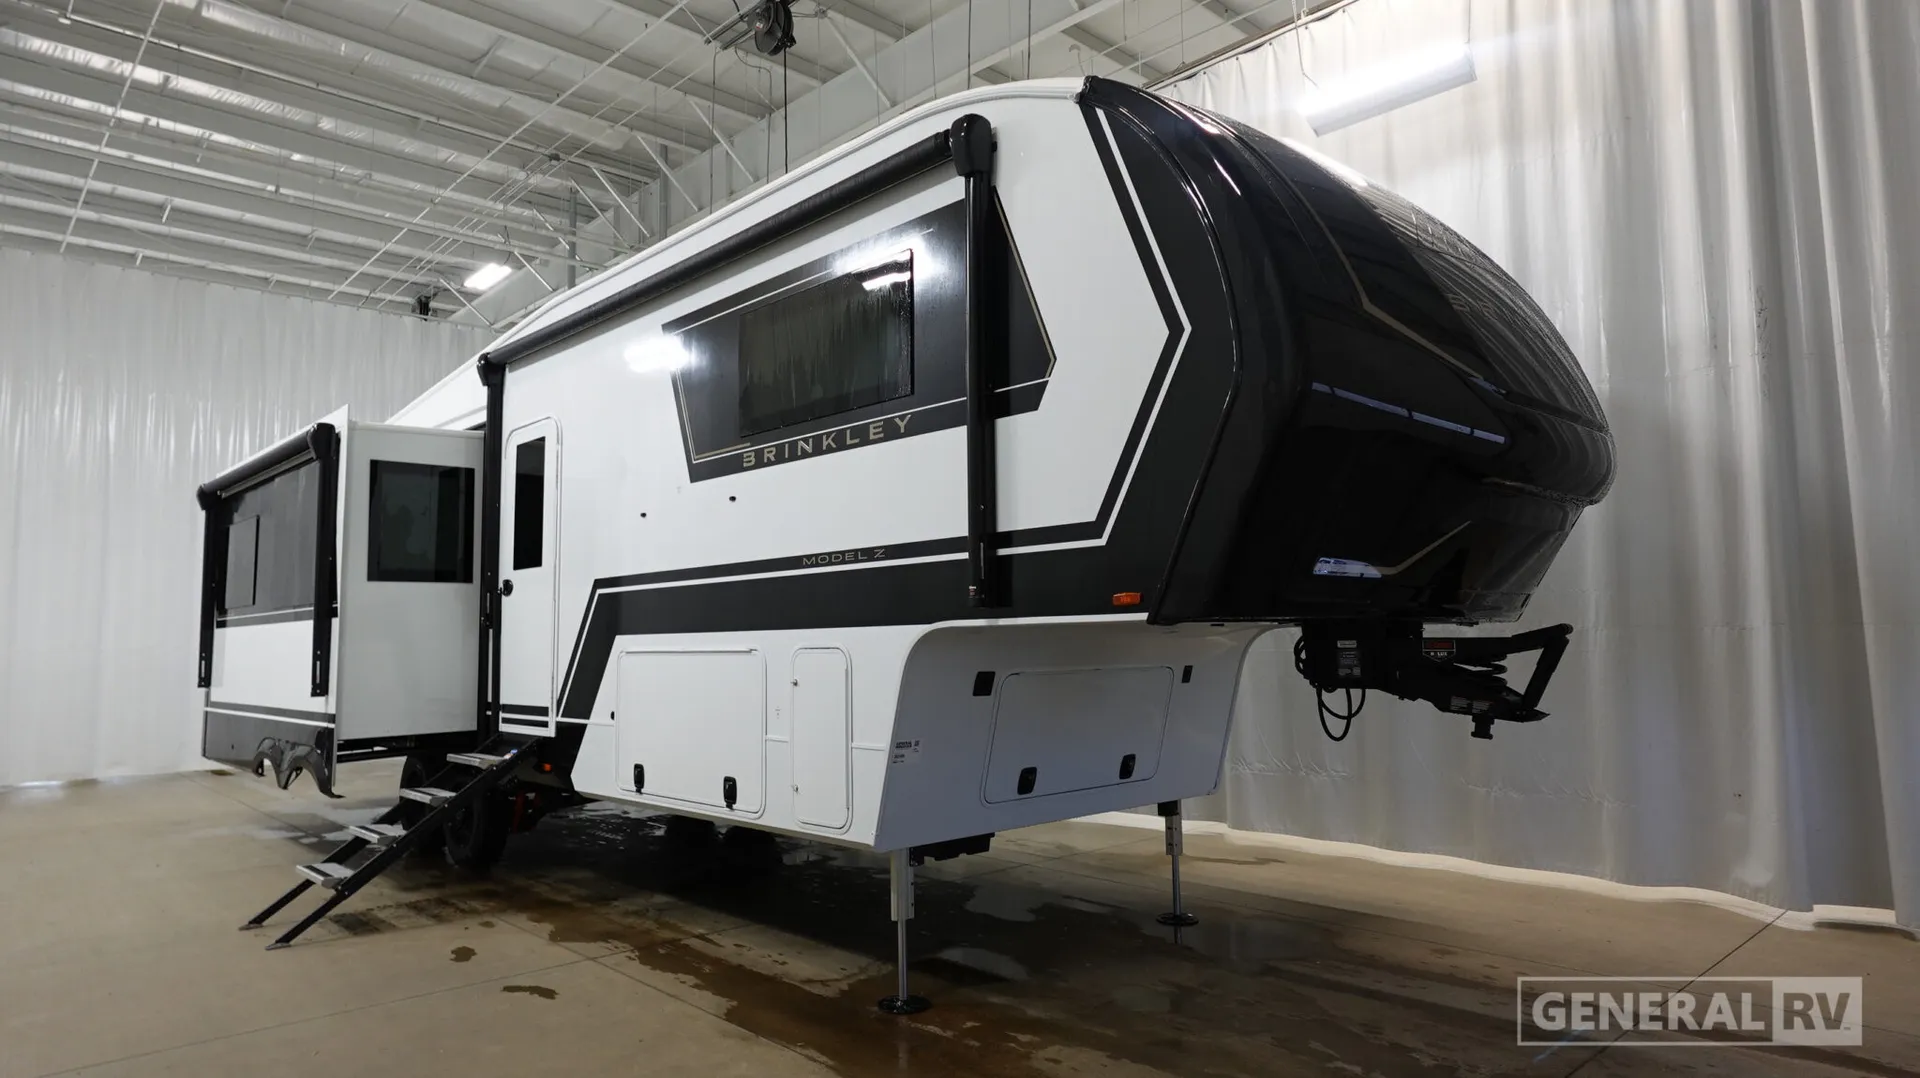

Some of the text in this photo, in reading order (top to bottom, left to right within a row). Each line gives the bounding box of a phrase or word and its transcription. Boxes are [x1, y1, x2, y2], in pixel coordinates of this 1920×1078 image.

[743, 415, 911, 467] BRINKLEY
[802, 549, 885, 565] MODEL Z
